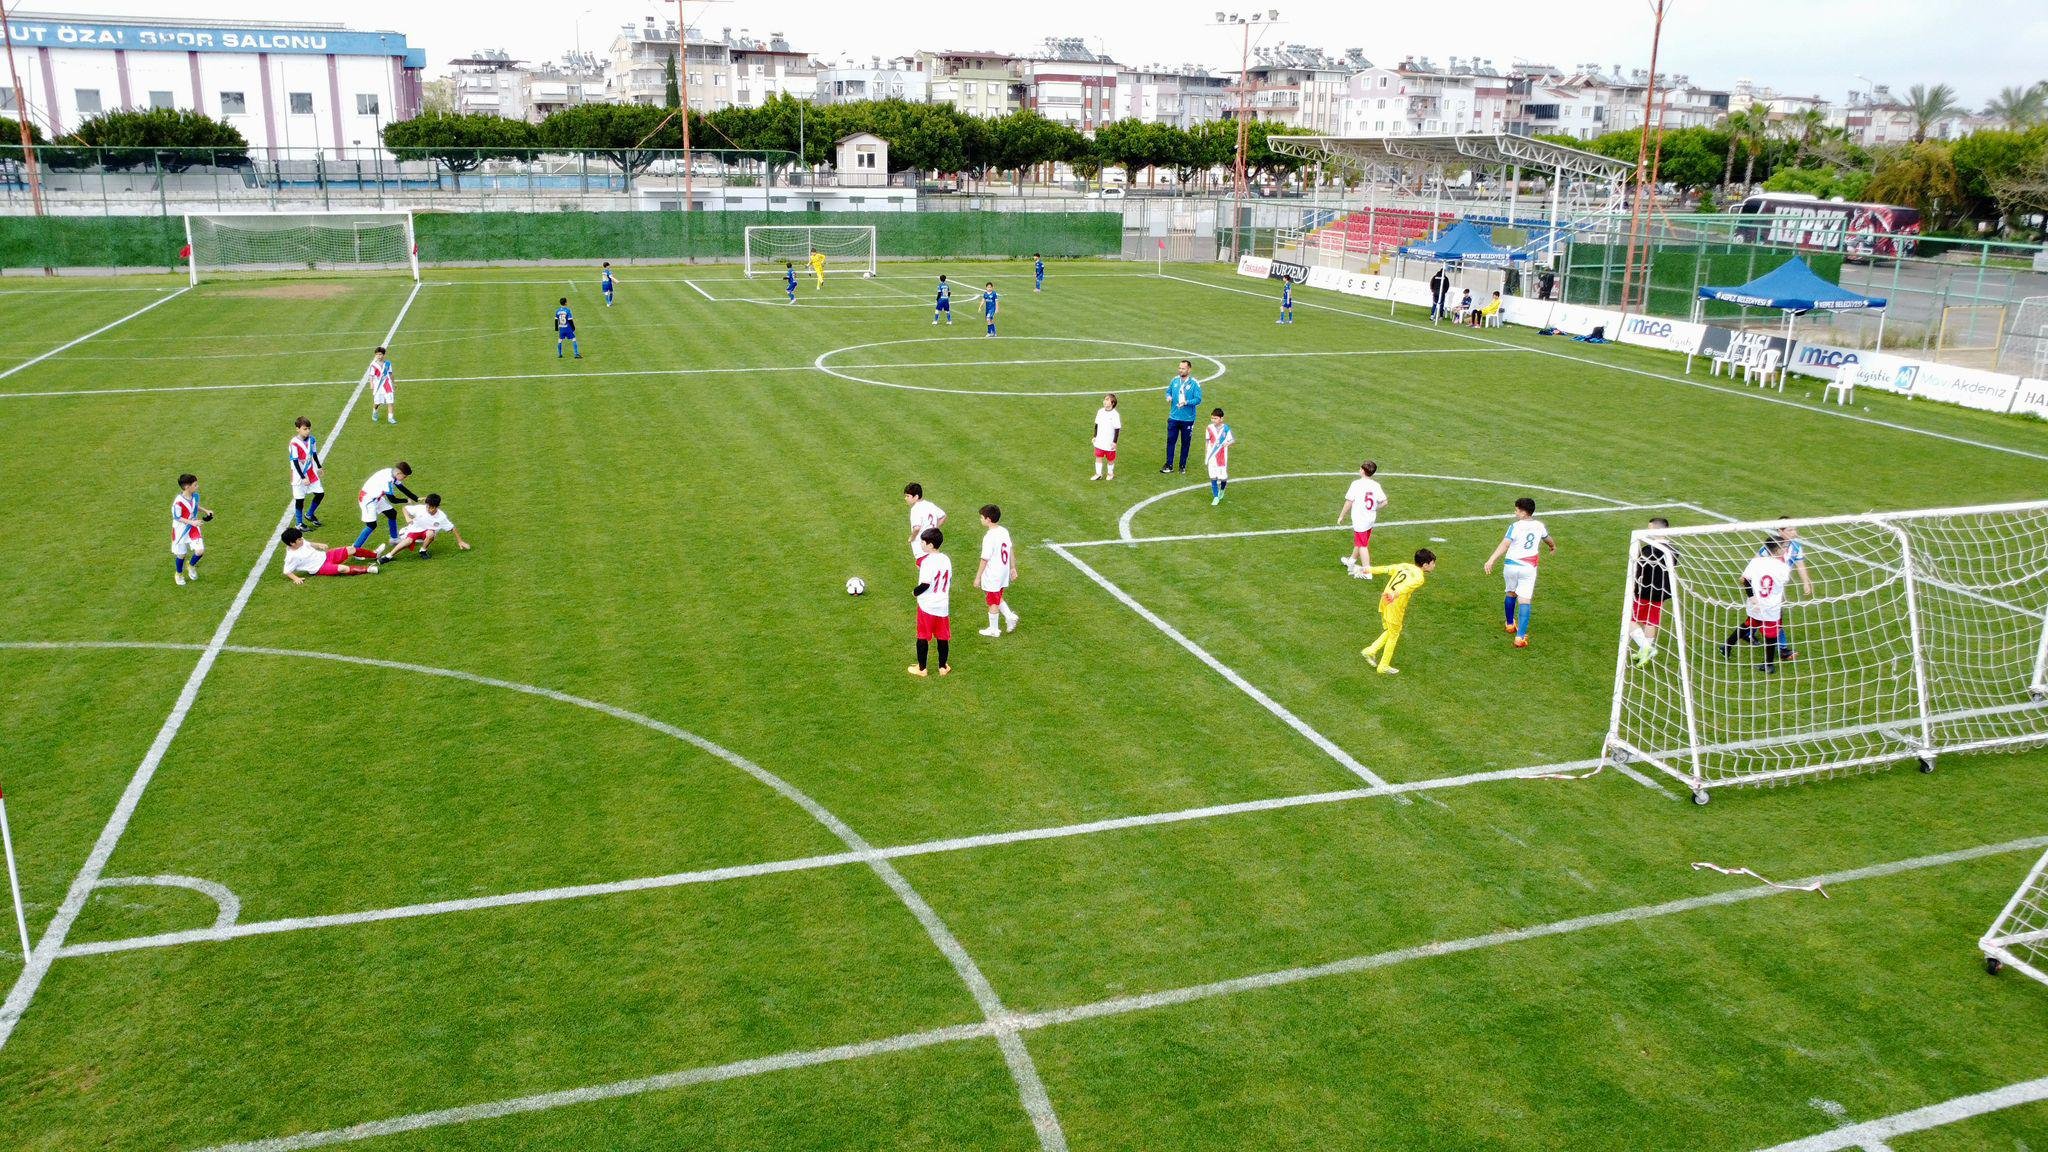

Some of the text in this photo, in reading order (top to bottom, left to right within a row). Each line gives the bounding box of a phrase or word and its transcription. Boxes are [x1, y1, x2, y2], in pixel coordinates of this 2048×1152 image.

[222, 33, 327, 50] SALONU
[1767, 206, 1848, 248] KEPEZ
[1627, 318, 1672, 338] mice
[1798, 346, 1859, 367] mice
[1951, 378, 2007, 398] Akdeniz
[2024, 391, 2048, 407] HA
[1364, 491, 1374, 511] 5
[1524, 533, 1535, 550] 8
[1001, 542, 1008, 565] 6
[933, 569, 949, 593] 11
[1389, 569, 1407, 591] 12
[1760, 574, 1774, 598] 9
